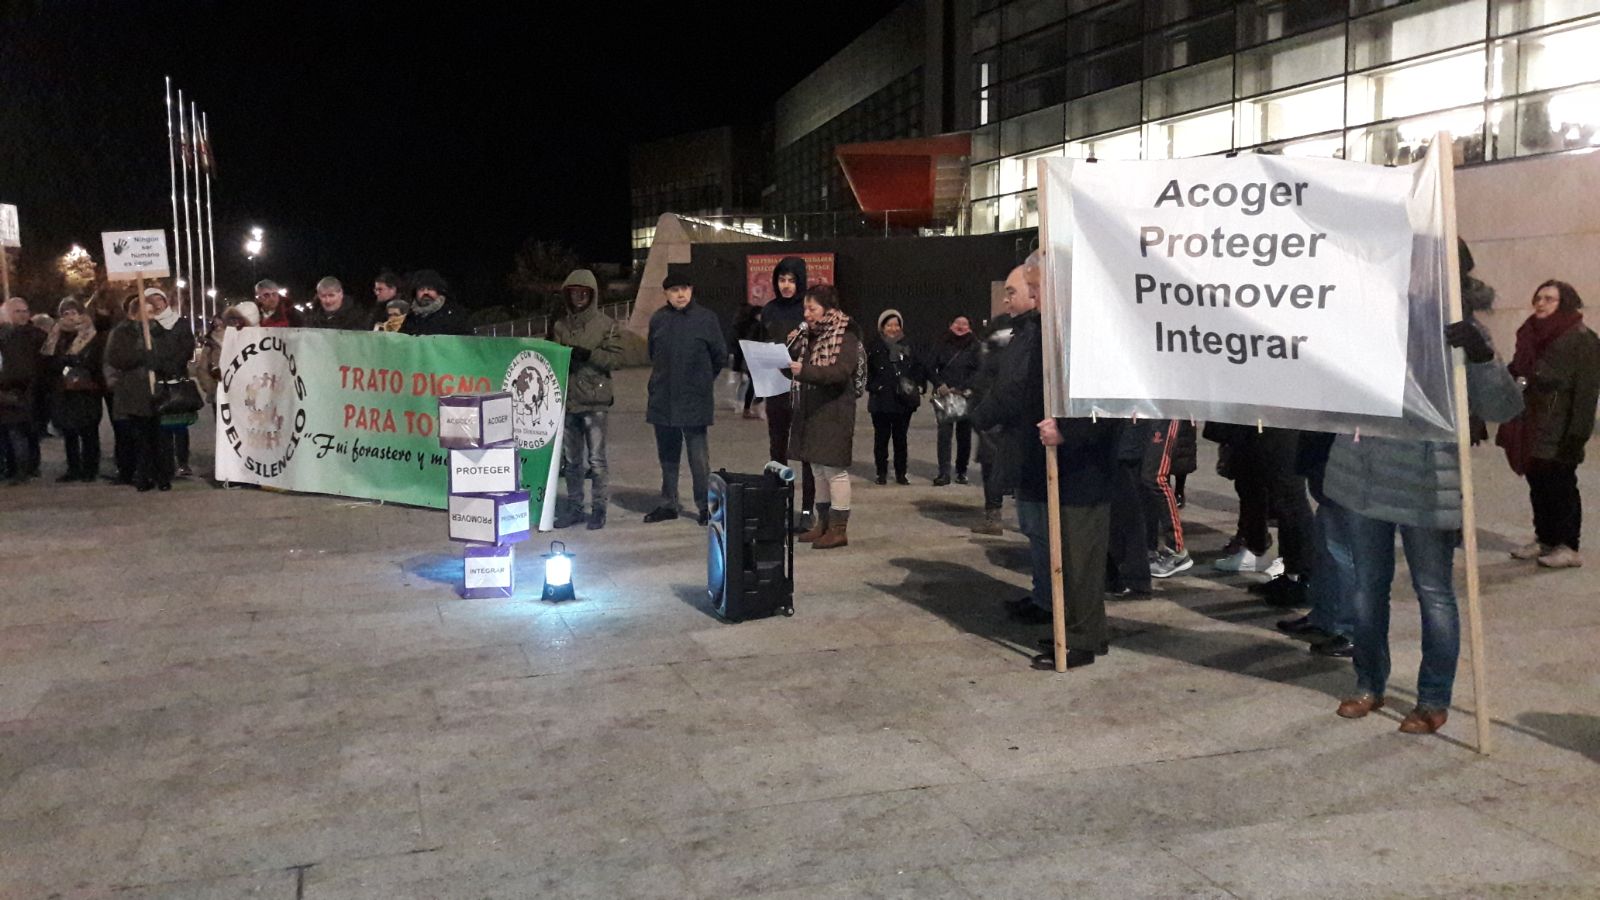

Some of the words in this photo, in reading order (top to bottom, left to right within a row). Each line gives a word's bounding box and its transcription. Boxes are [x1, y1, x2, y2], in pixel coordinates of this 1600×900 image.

[1154, 179, 1309, 216] Acoger
[1140, 226, 1327, 267] Proteger
[1135, 273, 1337, 309] Promover
[1155, 321, 1309, 365] Integrar
[223, 336, 307, 401] CIRCULOS
[339, 365, 403, 394] TRATO
[412, 373, 491, 397] DIGNO
[343, 404, 397, 433] PARA
[220, 402, 242, 458] DEL
[245, 408, 306, 478] SILENCIO
[352, 438, 412, 463] forastero
[417, 452, 425, 470] y
[456, 466, 510, 475] PROTEGER
[451, 513, 493, 525] PROMOVER
[469, 567, 505, 575] INTEGRAR
